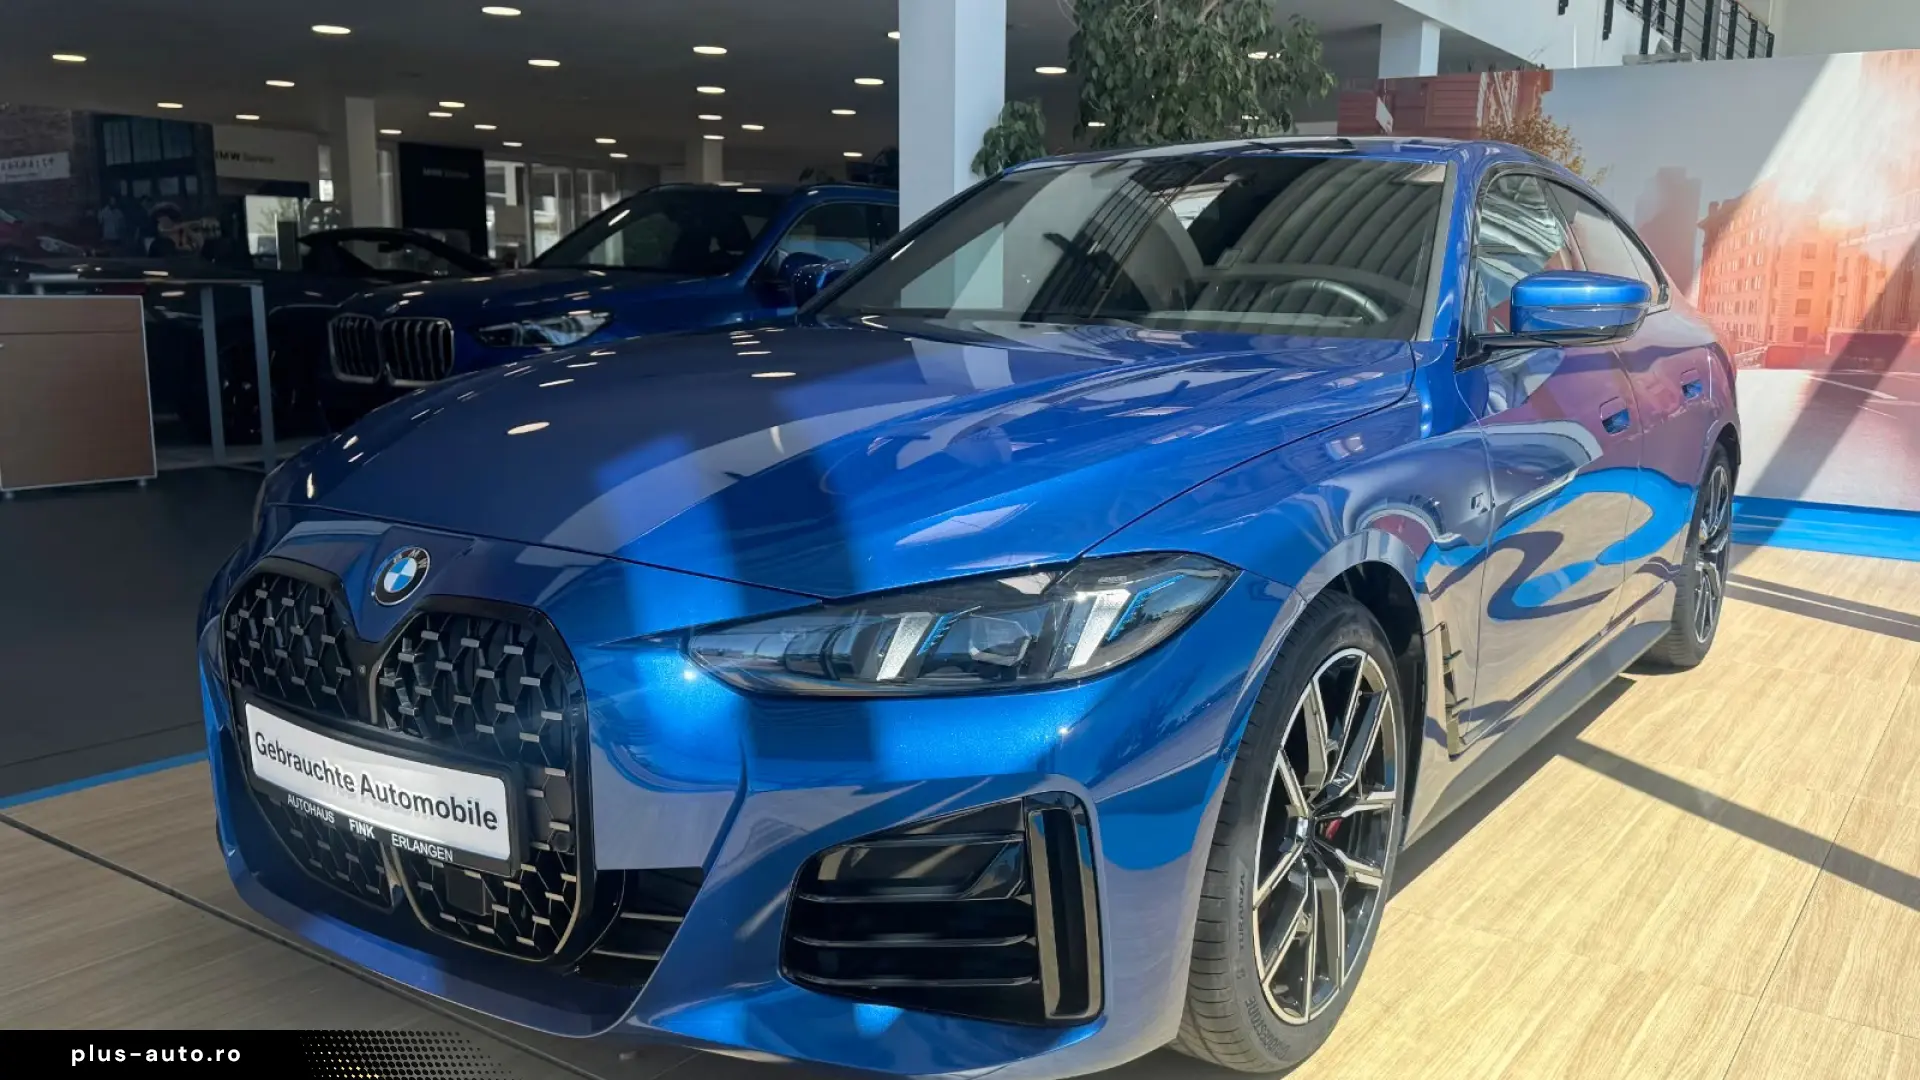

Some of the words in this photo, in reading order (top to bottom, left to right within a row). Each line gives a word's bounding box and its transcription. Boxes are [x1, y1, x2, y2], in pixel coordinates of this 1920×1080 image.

[255, 731, 355, 792] Gebrauchte
[361, 773, 498, 830] Automobile
[287, 794, 335, 823] AUTOHAUS
[348, 818, 376, 839] FINK
[392, 834, 453, 862] ERLANGEN
